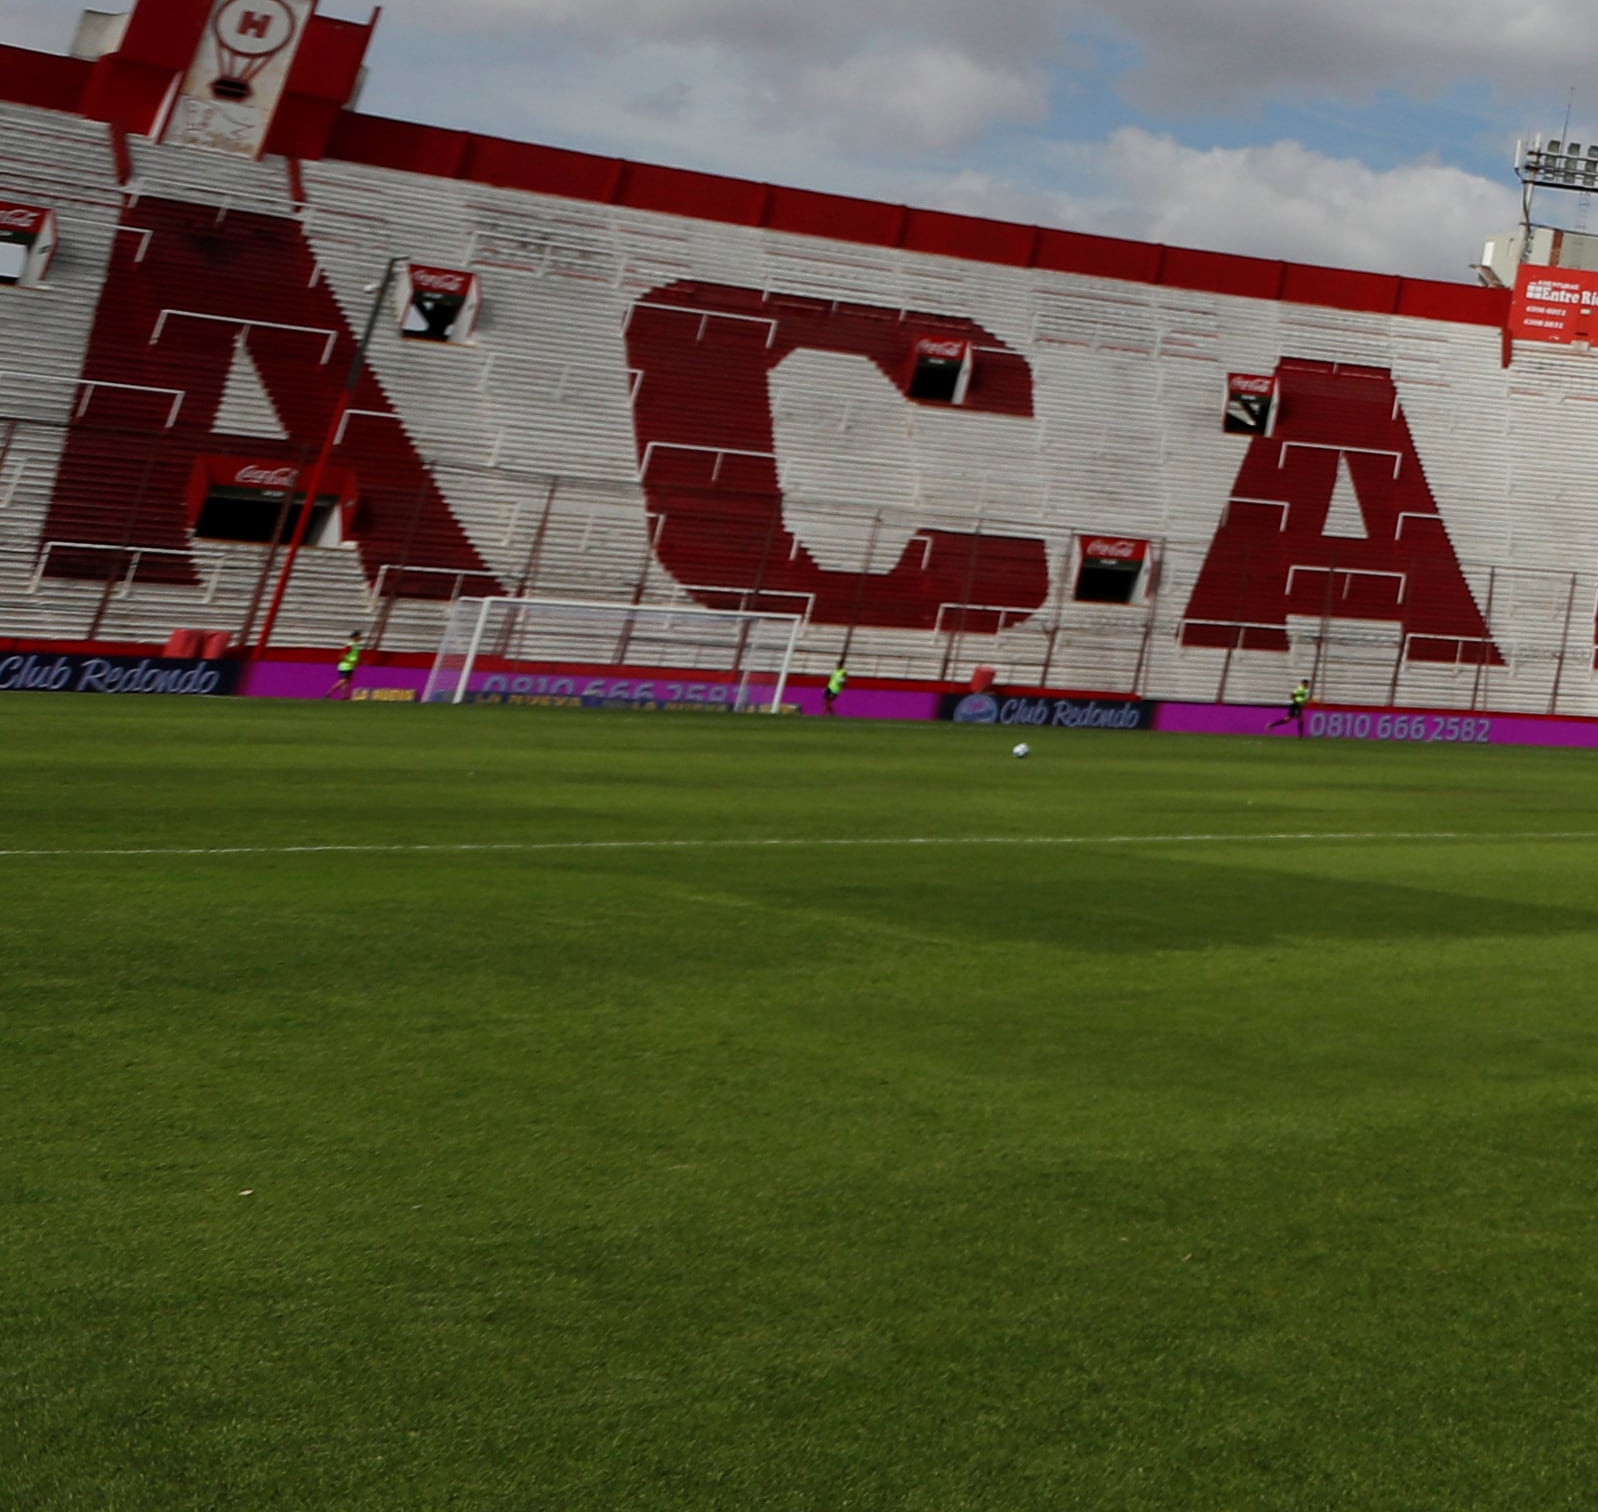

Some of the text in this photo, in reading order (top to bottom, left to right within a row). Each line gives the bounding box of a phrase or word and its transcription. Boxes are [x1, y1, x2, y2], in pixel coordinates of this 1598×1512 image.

[236, 10, 273, 39] H
[0, 654, 222, 695] Club Redondo
[1000, 699, 1052, 726] Club
[1053, 703, 1141, 729] Redondo
[1309, 712, 1492, 743] 0810 666 2582
